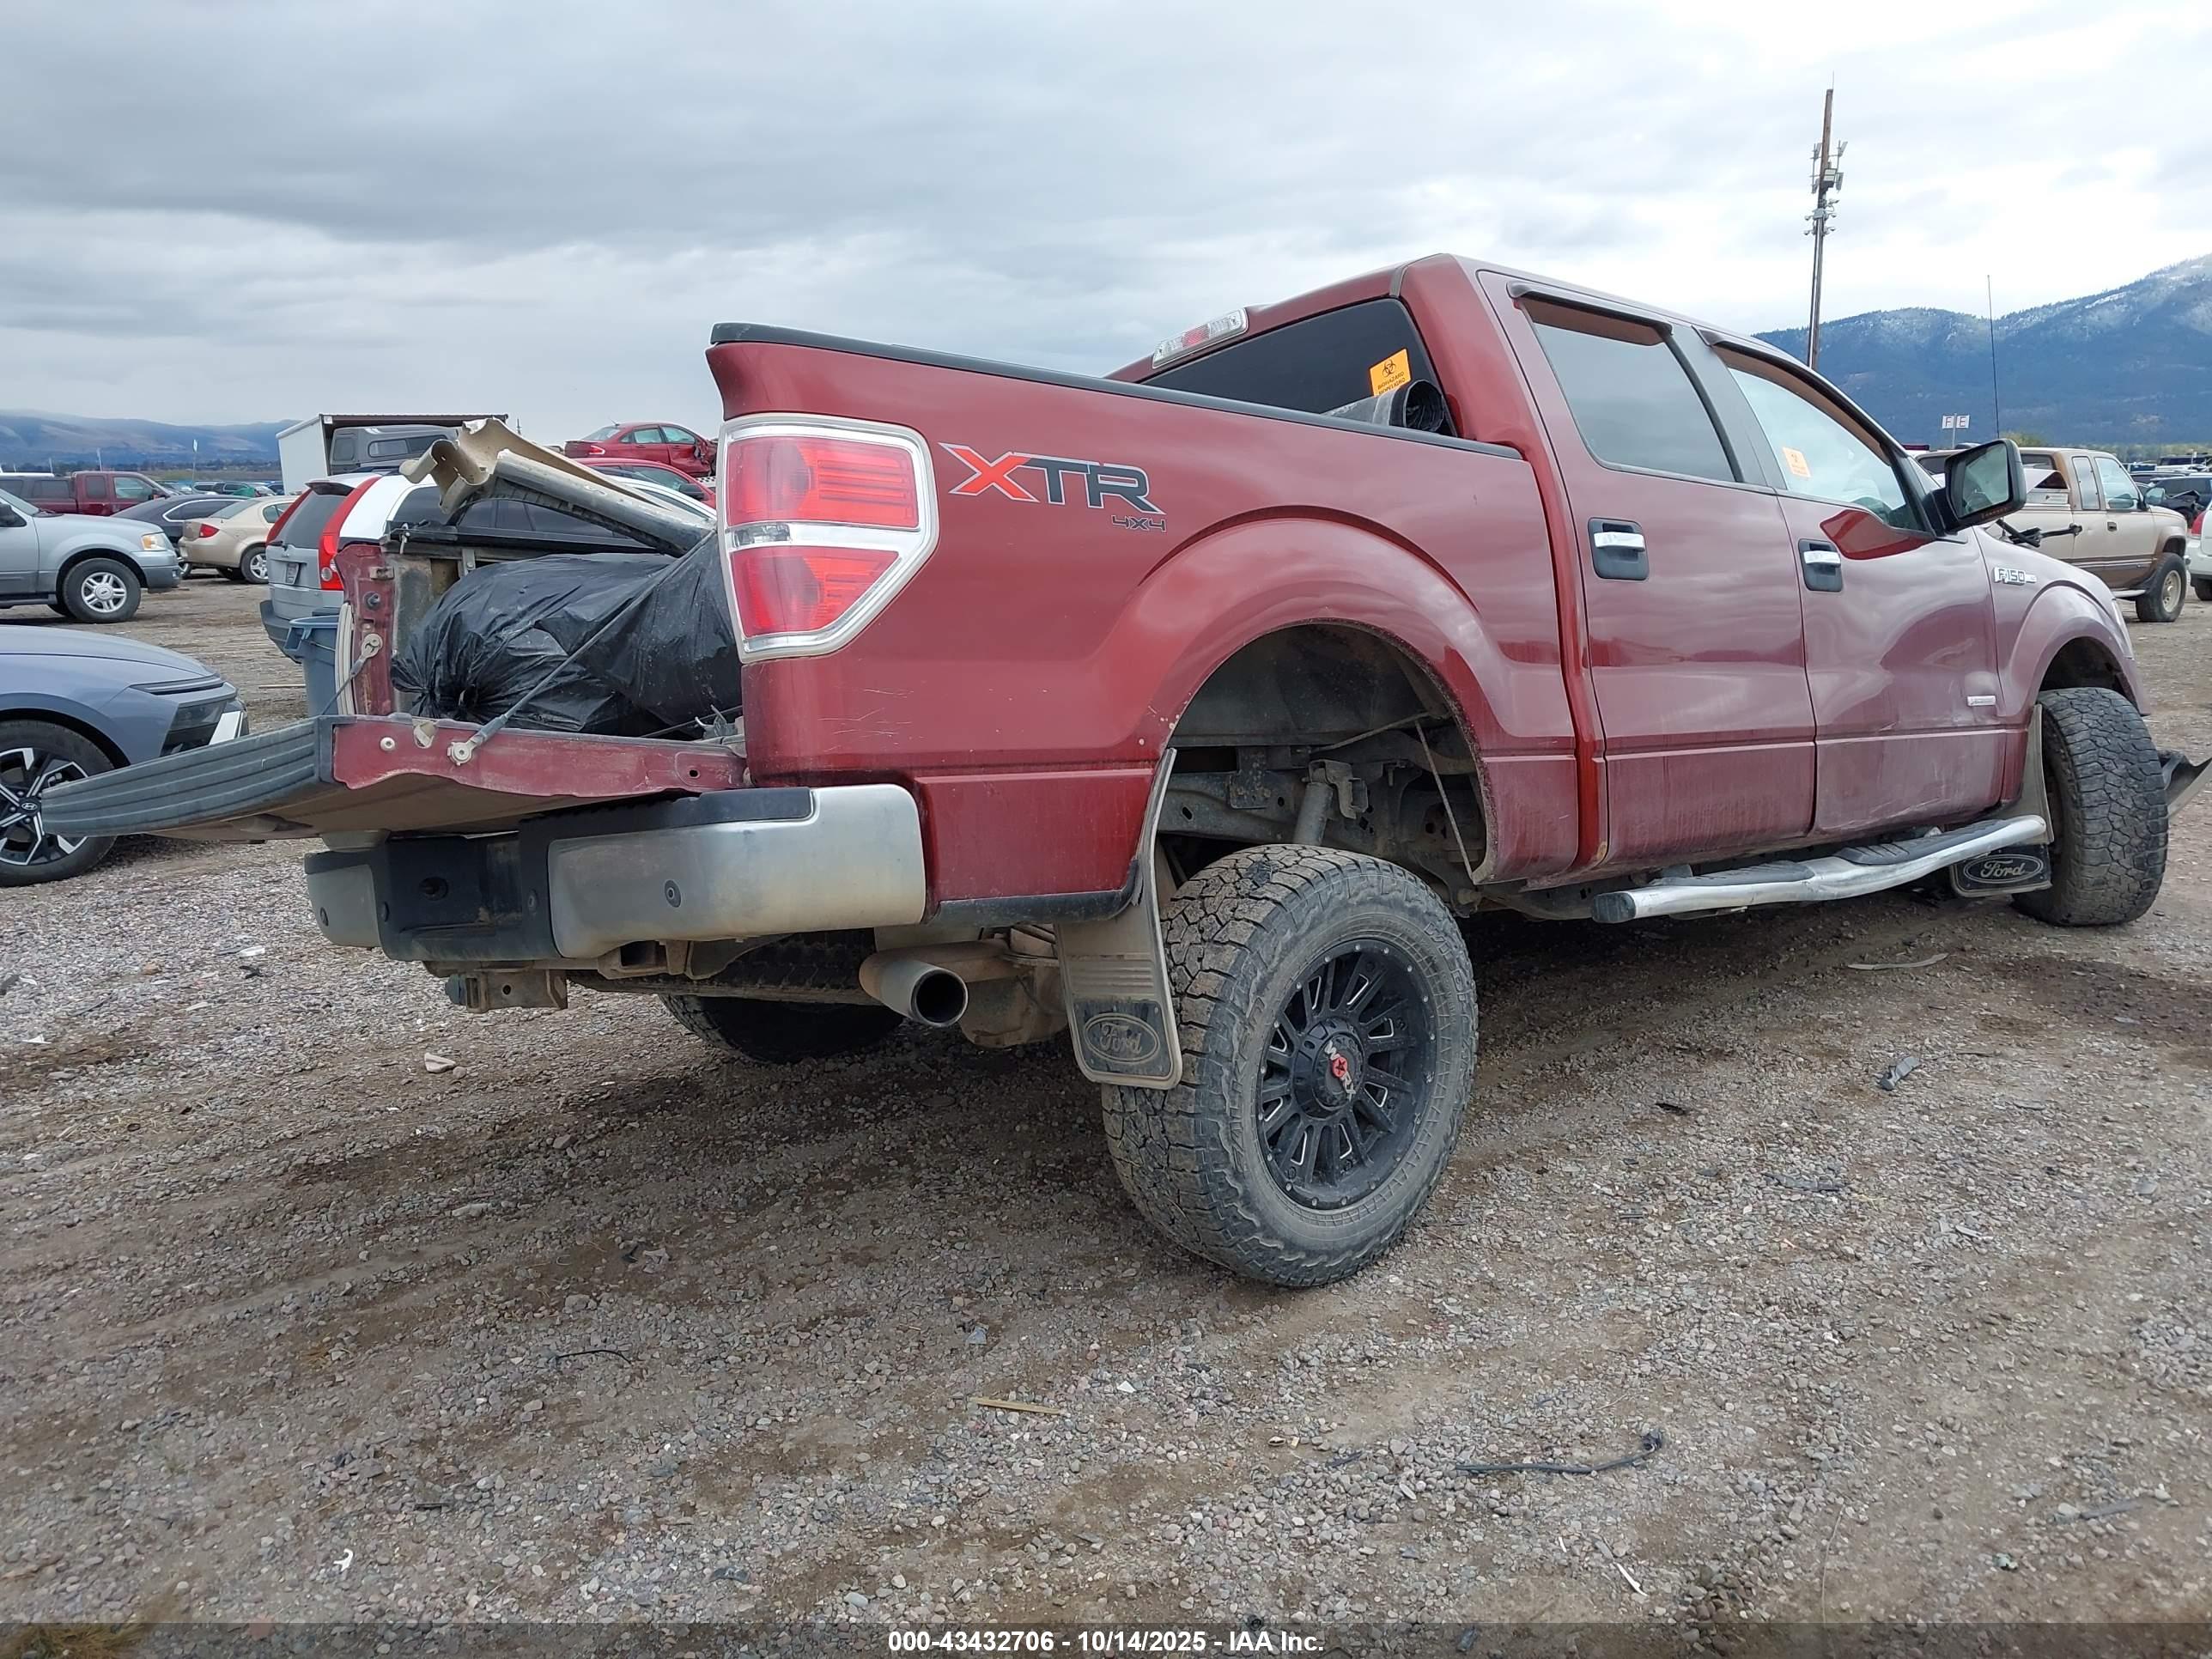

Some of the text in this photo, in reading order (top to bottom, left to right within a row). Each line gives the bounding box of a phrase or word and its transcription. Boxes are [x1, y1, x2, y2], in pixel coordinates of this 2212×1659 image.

[1945, 416, 1952, 427] F
[938, 442, 1167, 515] XTR
[1980, 860, 2026, 878] Ford
[1100, 1022, 1142, 1054] Ford
